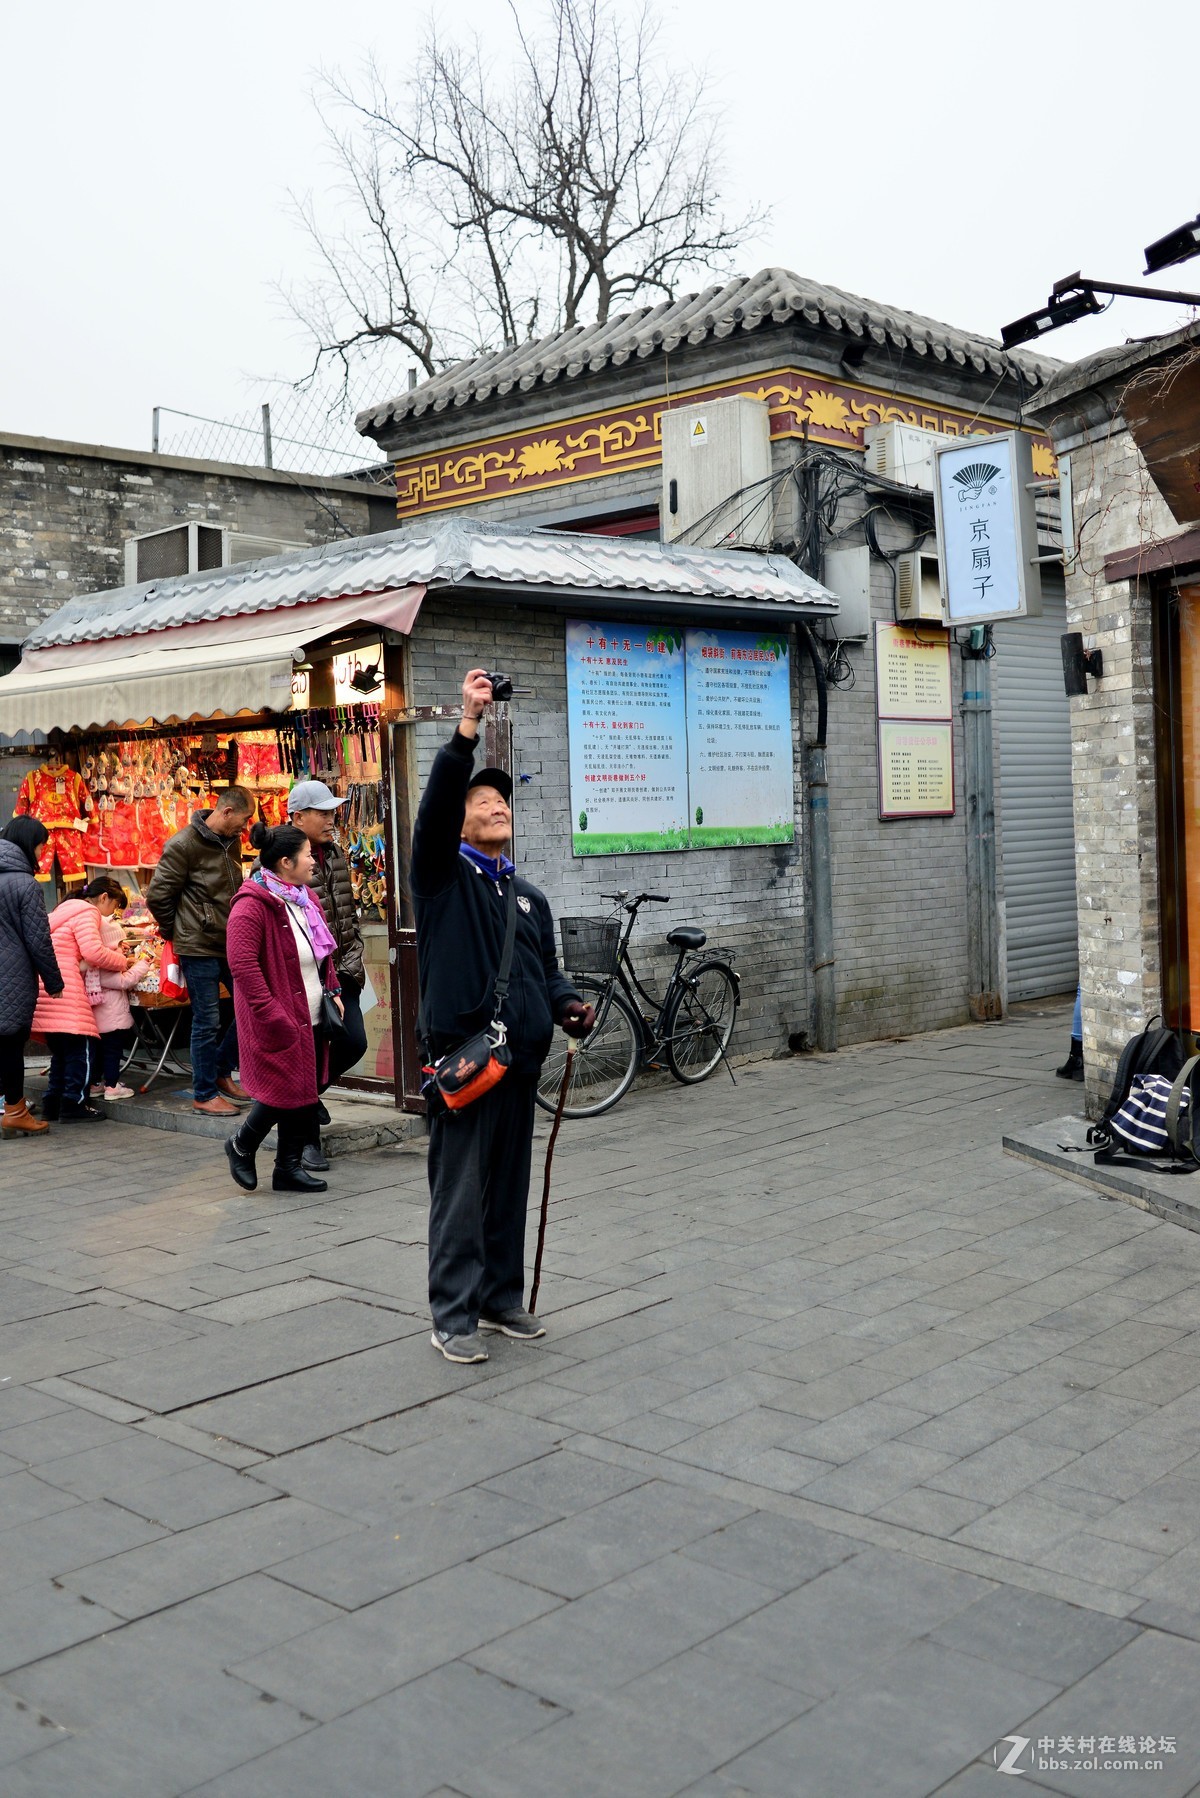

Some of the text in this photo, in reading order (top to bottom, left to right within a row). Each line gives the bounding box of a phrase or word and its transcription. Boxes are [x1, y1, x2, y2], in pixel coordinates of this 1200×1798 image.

[969, 518, 994, 600] 京扇子
[586, 636, 667, 654] 十有十无一创建
[580, 656, 604, 665] 十有十无
